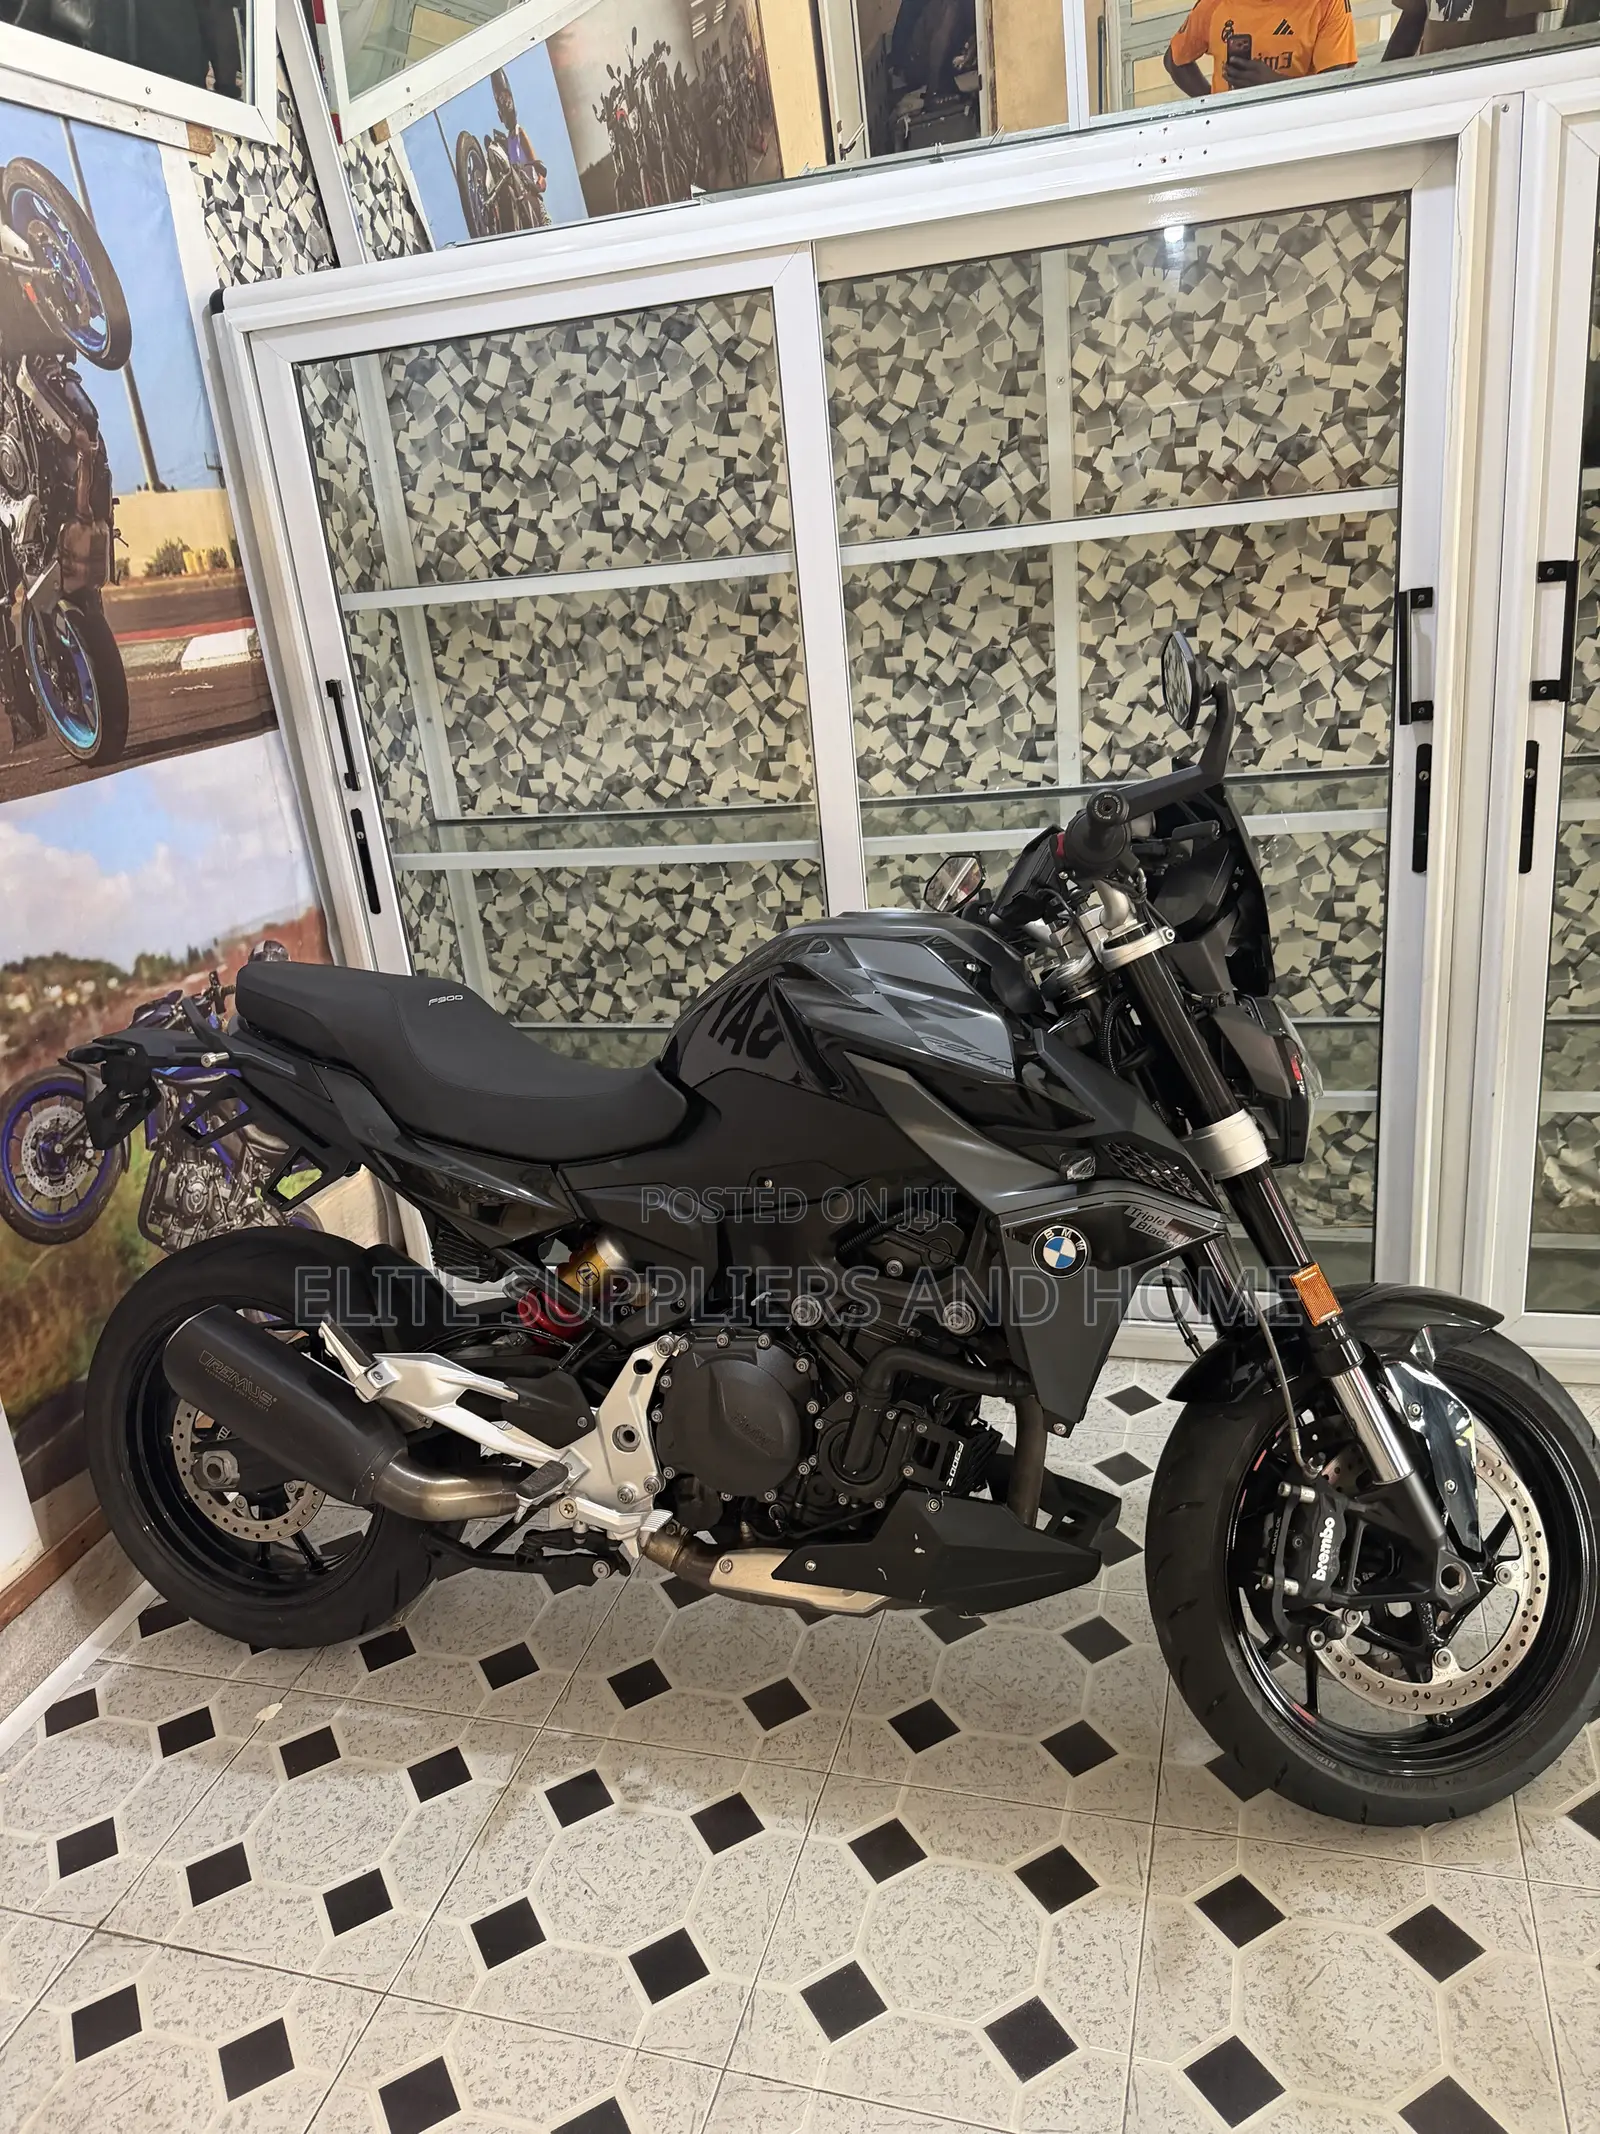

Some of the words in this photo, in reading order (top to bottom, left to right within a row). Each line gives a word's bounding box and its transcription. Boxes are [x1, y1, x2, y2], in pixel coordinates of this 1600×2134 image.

[428, 994, 464, 1006] F900
[1131, 1206, 1166, 1226] Triple
[1043, 1227, 1087, 1251] BMW
[1136, 1220, 1173, 1240] Black
[1311, 1516, 1336, 1581] brembo
